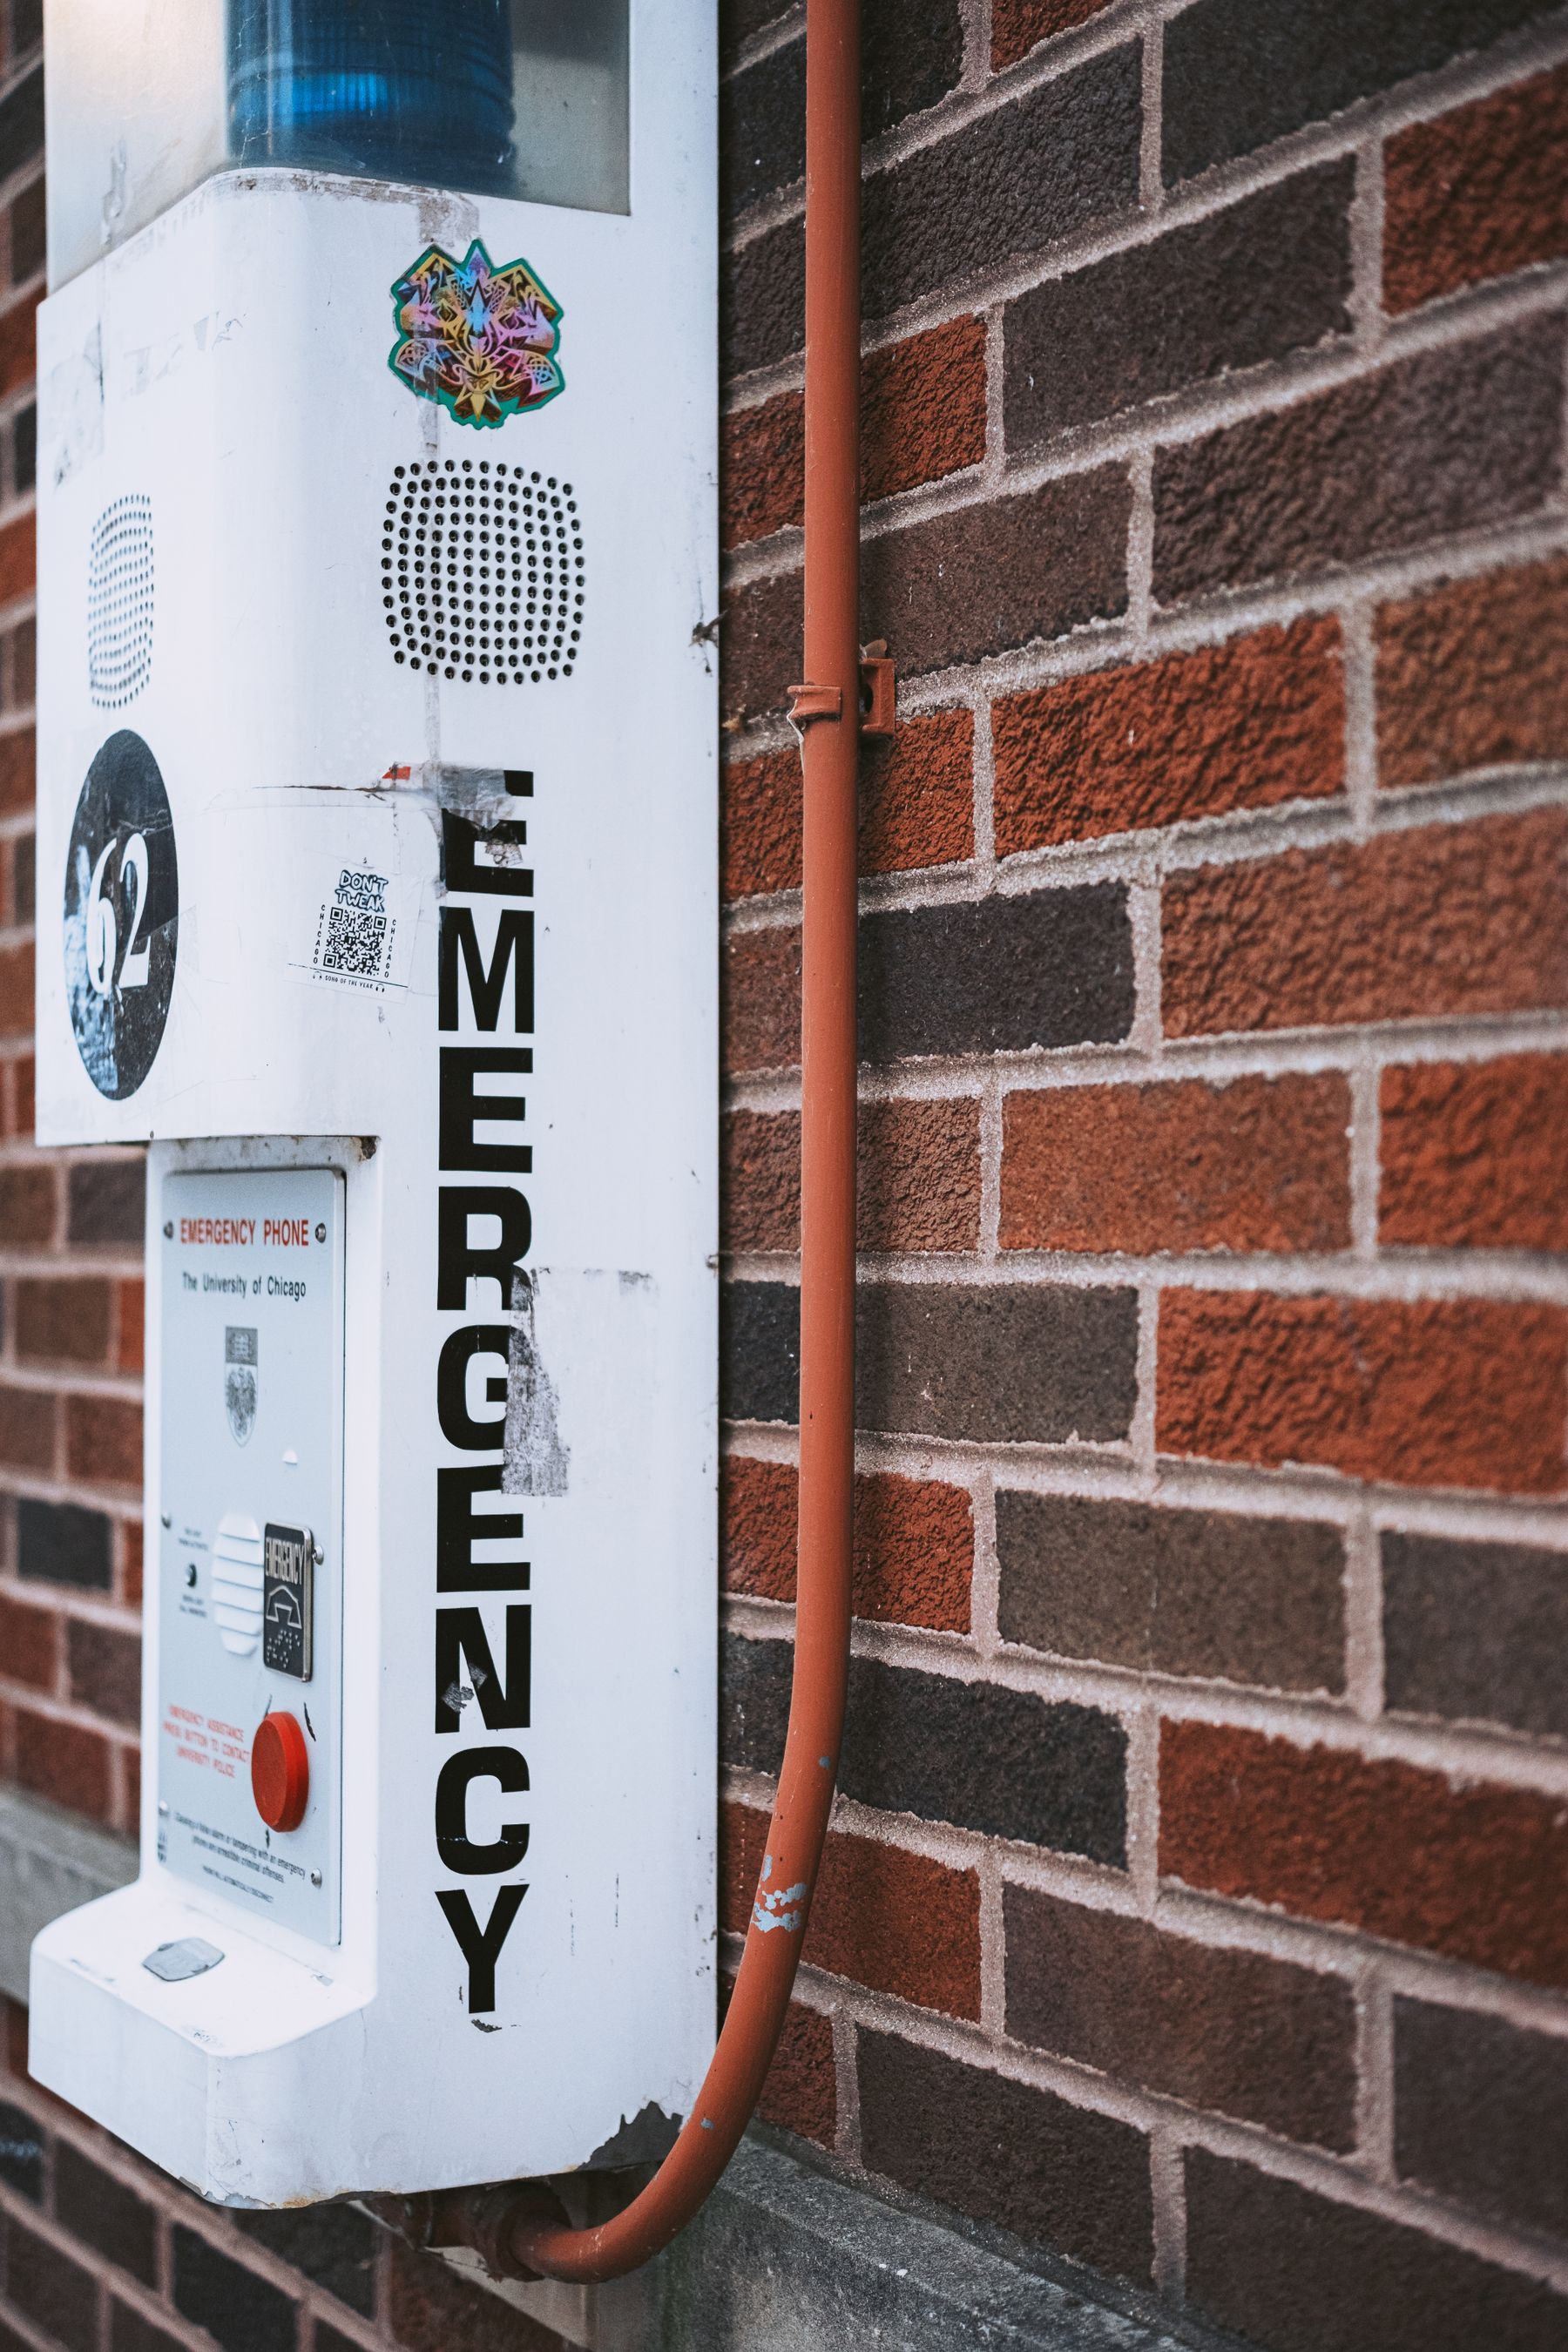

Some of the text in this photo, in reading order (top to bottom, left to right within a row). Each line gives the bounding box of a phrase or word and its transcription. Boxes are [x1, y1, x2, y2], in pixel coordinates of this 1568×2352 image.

[340, 869, 389, 894] DON'T
[87, 833, 152, 994] 62
[335, 889, 385, 913] TWEAK
[313, 904, 326, 964] CHICAGO
[384, 919, 396, 978] CHICAGO
[359, 981, 373, 990] YEAR
[180, 1218, 309, 1247] EMERGENCY PHONE
[182, 1271, 307, 1302] The University of Chicago
[436, 768, 535, 2014] EMERGENCY
[265, 1536, 304, 1585] EMERGENCY
[211, 1738, 220, 1753] TO
[223, 1742, 250, 1763] CONTACT
[278, 1858, 306, 1880] emergency
